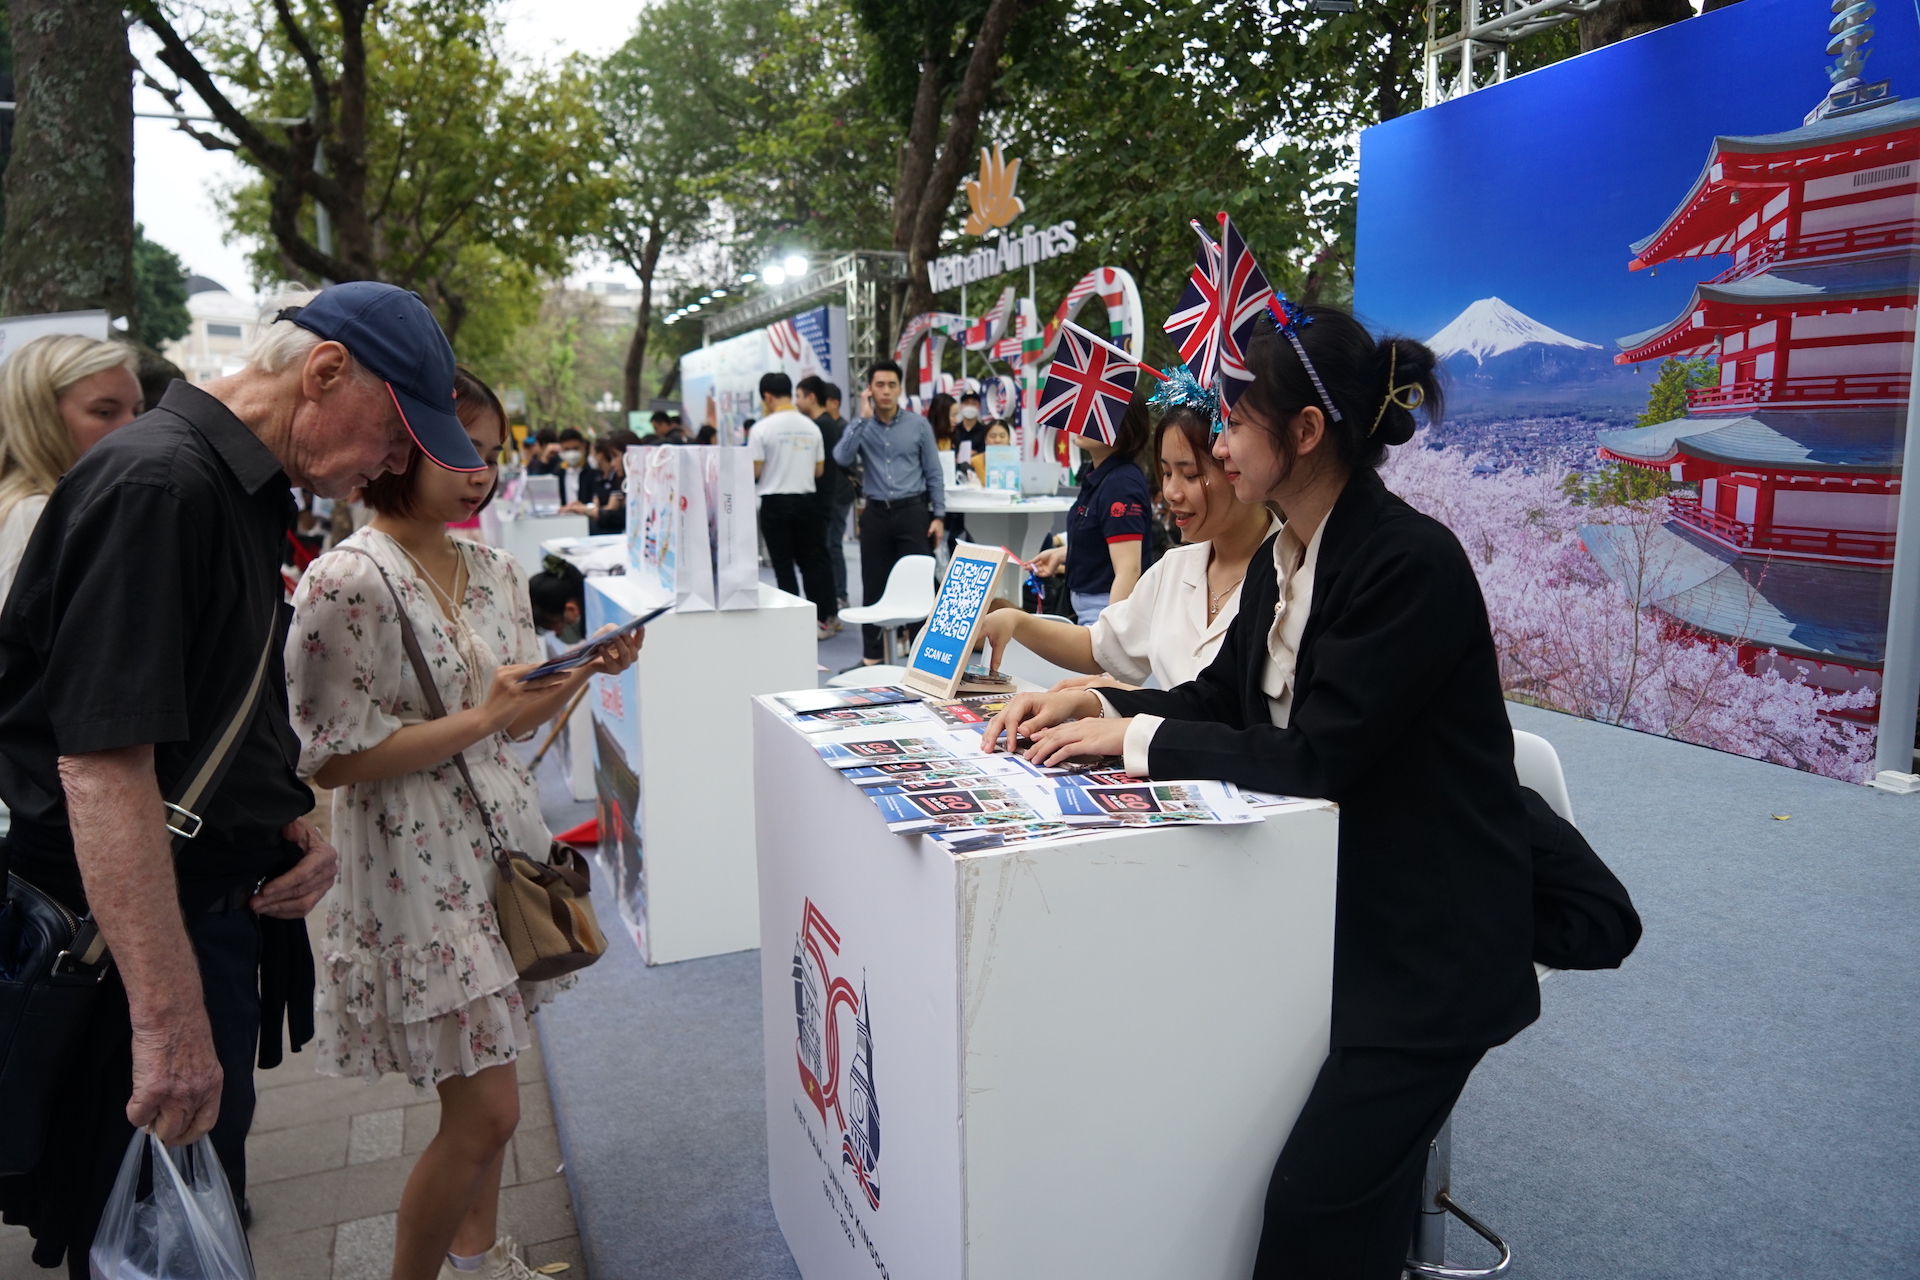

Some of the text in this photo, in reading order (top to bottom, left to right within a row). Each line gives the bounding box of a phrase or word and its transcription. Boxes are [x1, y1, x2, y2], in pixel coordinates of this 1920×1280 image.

[923, 647, 953, 664] SCAN ME
[867, 742, 897, 754] GO
[938, 795, 973, 810] GO
[1118, 793, 1152, 810] GO
[793, 1098, 807, 1131] VIET
[807, 1130, 823, 1161] NAM
[827, 1163, 854, 1219] UNITED
[822, 1179, 835, 1210] 1973
[840, 1213, 856, 1249] 2023
